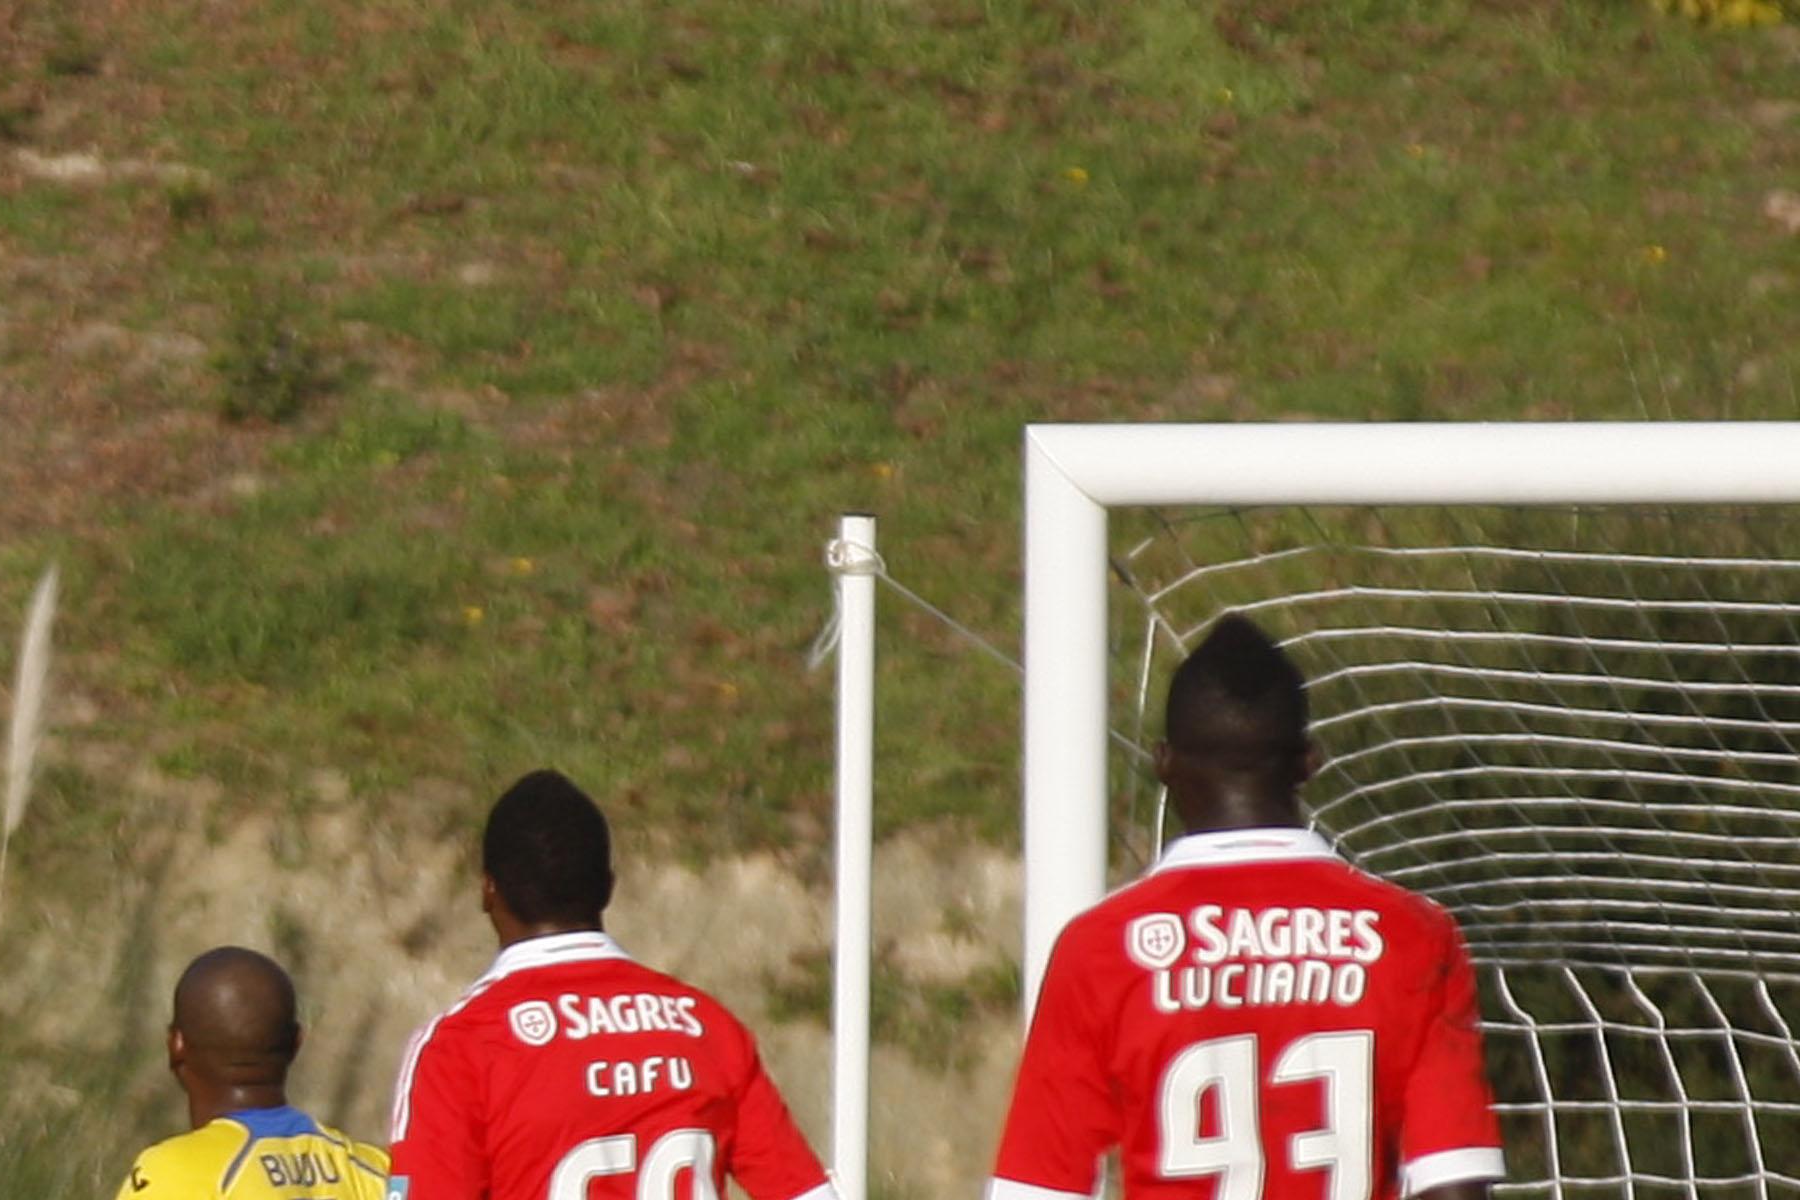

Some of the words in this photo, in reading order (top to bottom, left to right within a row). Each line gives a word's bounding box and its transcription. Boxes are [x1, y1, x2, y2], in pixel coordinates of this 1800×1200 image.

[1190, 904, 1384, 963] SAGRES
[1154, 962, 1367, 1012] LUCIANO
[559, 992, 703, 1040] SAGRES
[587, 1057, 694, 1096] CAFU
